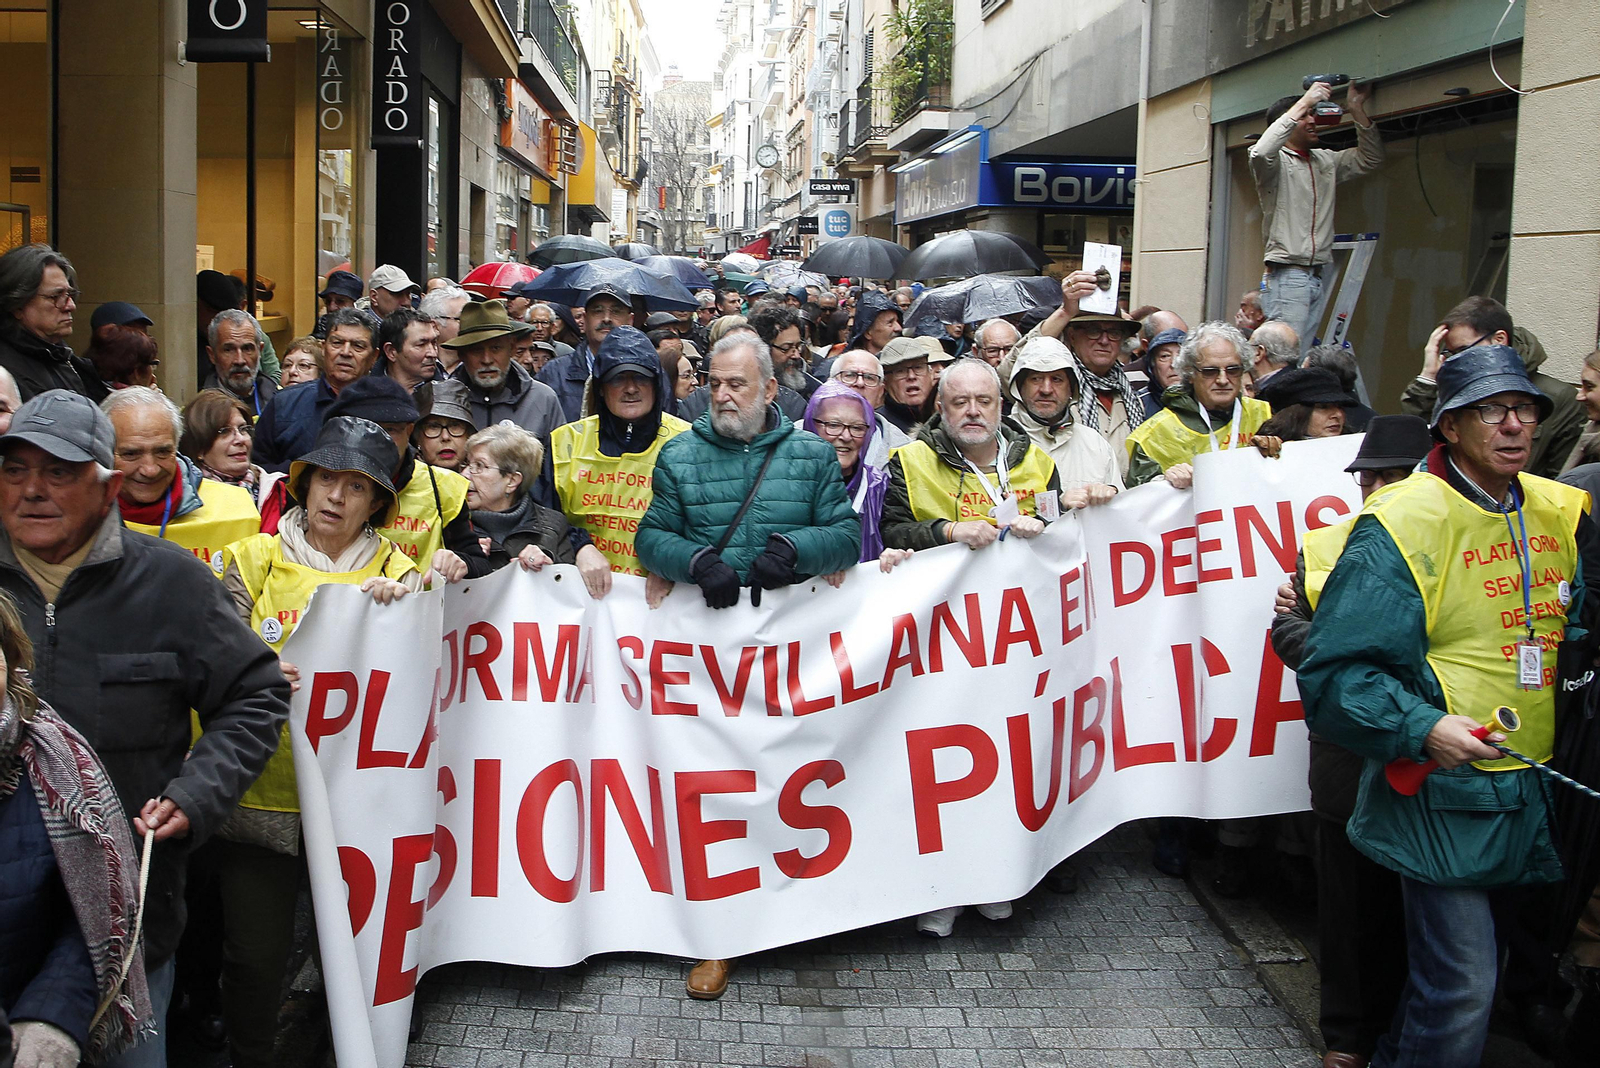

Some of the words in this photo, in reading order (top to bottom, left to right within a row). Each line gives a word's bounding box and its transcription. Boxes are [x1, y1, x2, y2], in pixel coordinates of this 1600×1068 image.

[811, 183, 831, 191] casa
[832, 182, 850, 191] viva
[1013, 167, 1136, 205] Bovi
[828, 215, 847, 223] tuc
[828, 224, 847, 232] tuc
[578, 469, 653, 489] PLATAFOR
[581, 493, 648, 511] SEVILLAN
[586, 514, 639, 533] DEFENS
[1462, 534, 1561, 569] PLATAORMA
[616, 587, 1043, 718] SEVILLANA
